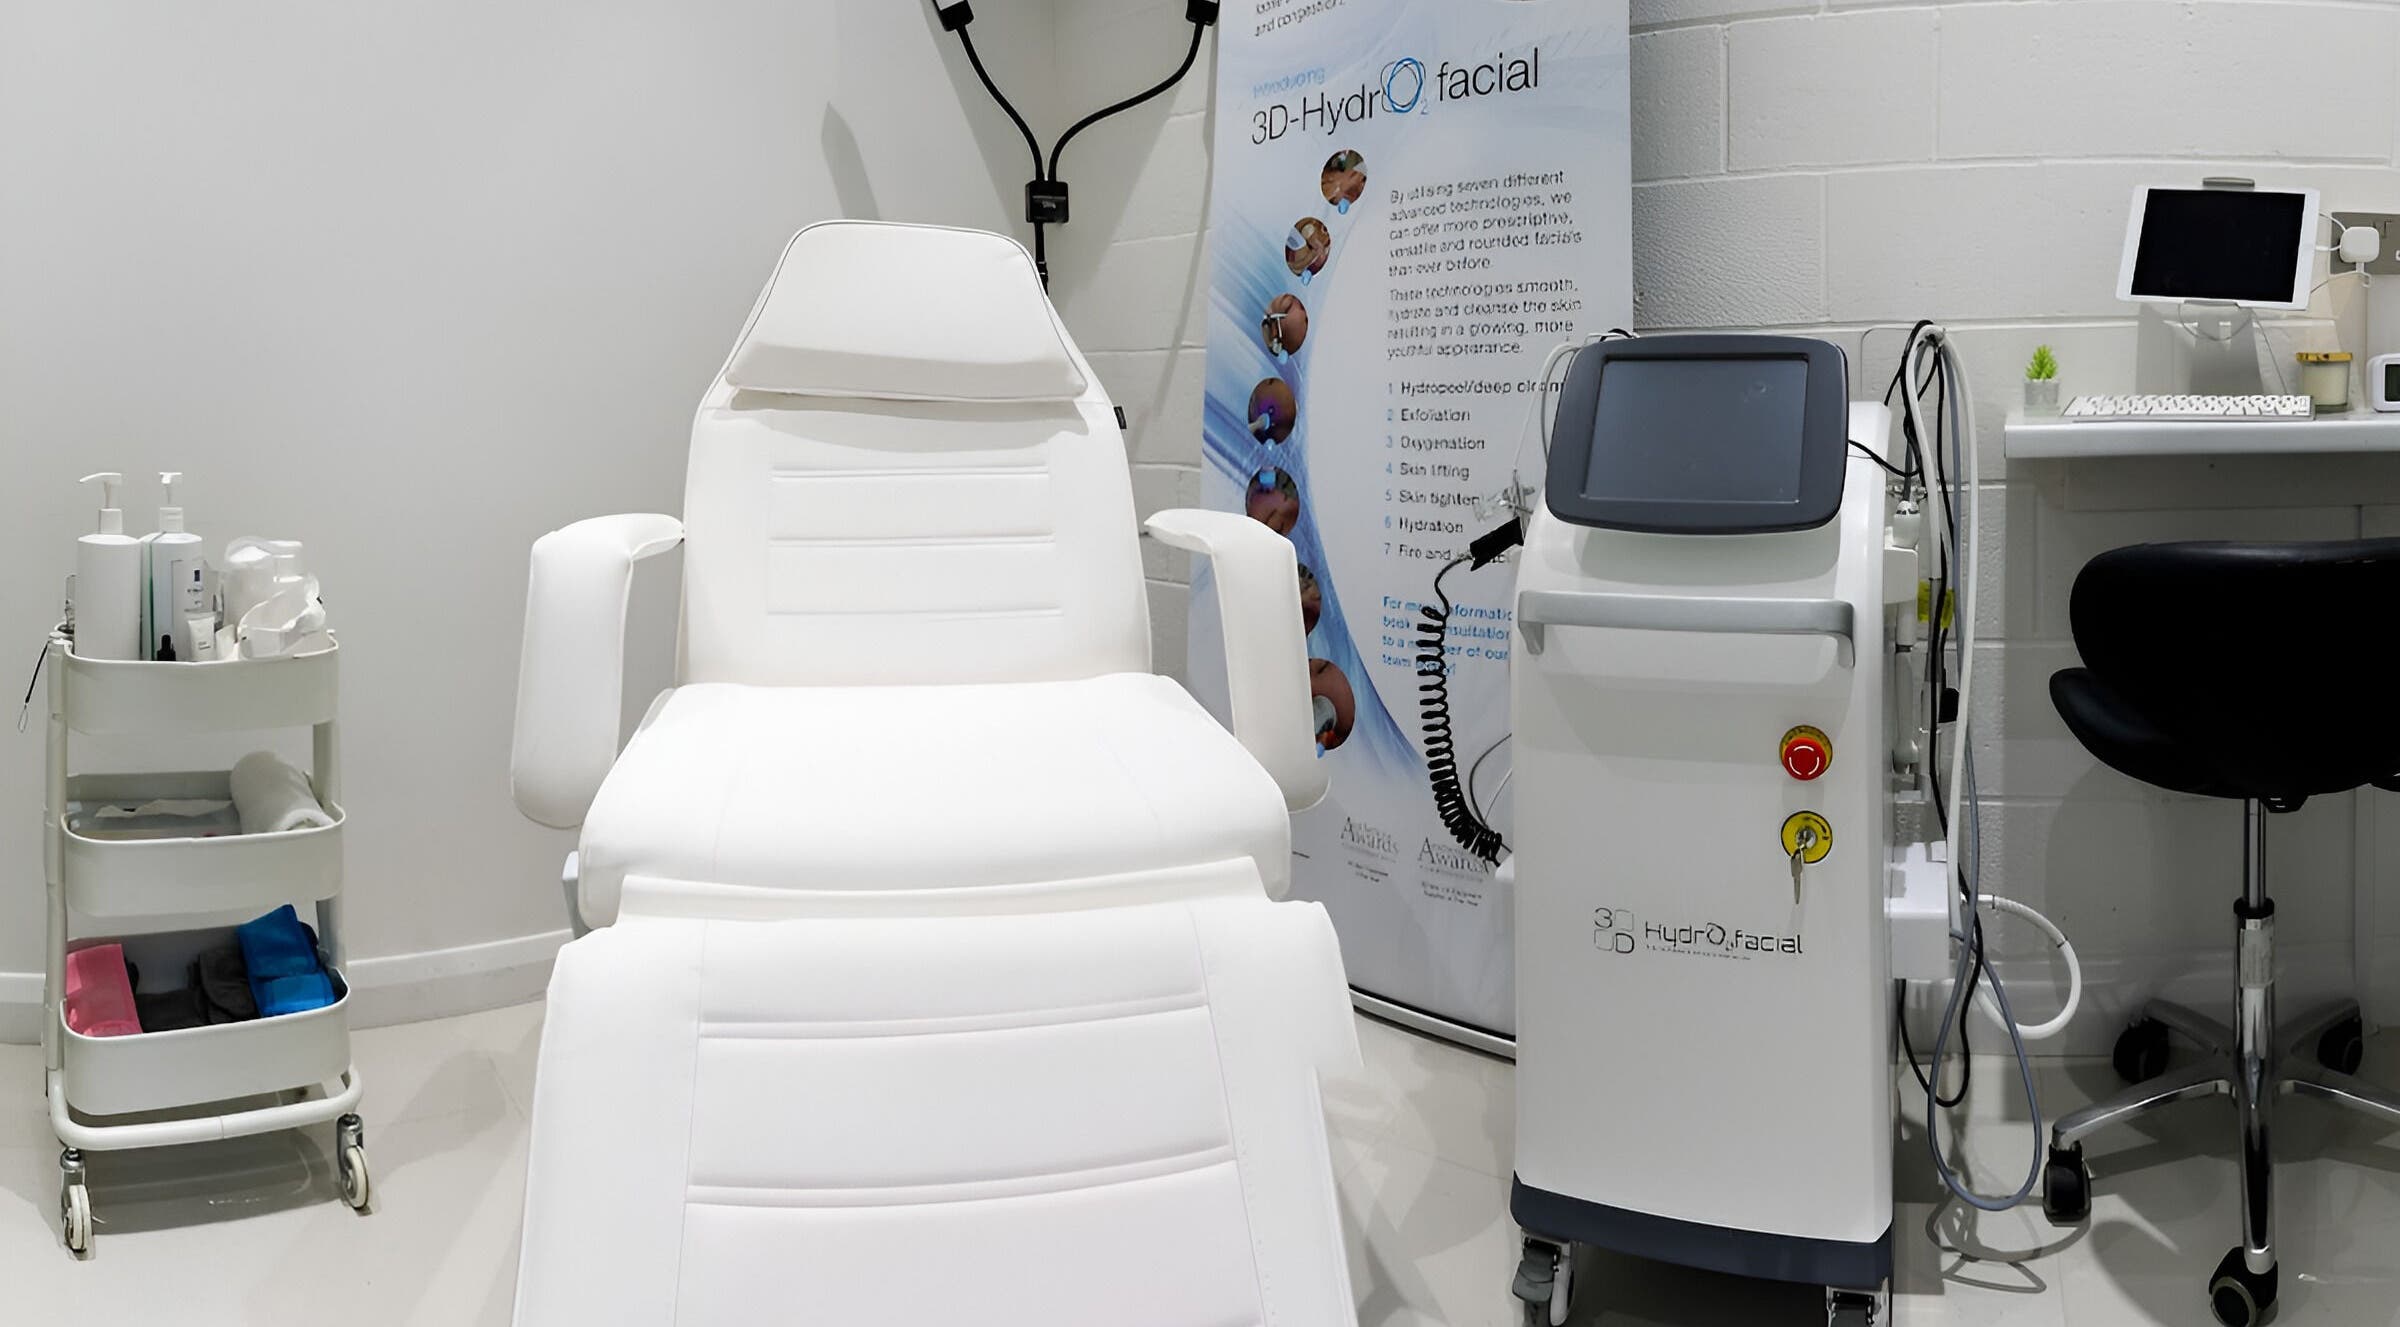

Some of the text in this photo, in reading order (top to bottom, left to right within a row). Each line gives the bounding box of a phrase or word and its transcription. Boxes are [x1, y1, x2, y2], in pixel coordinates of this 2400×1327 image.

[1437, 47, 1539, 102] facial
[1457, 178, 1499, 193] seven
[1503, 170, 1564, 188] different
[1551, 192, 1572, 205] we
[1443, 219, 1479, 233] more
[1440, 238, 1465, 253] and
[1469, 234, 1529, 250] rounded
[1435, 304, 1459, 318] and
[1464, 301, 1519, 317] cleanse
[1523, 299, 1547, 313] the
[1535, 319, 1574, 333] more
[1386, 408, 1470, 422] 2 Exfoliation
[1401, 437, 1485, 452] Oxygenation
[1385, 462, 1470, 481] 4 Skin lifting
[1400, 489, 1426, 503] Skin
[1430, 492, 1480, 508] tighten
[1400, 517, 1464, 534] Hydration
[1384, 542, 1392, 555] 7
[1425, 549, 1452, 561] and
